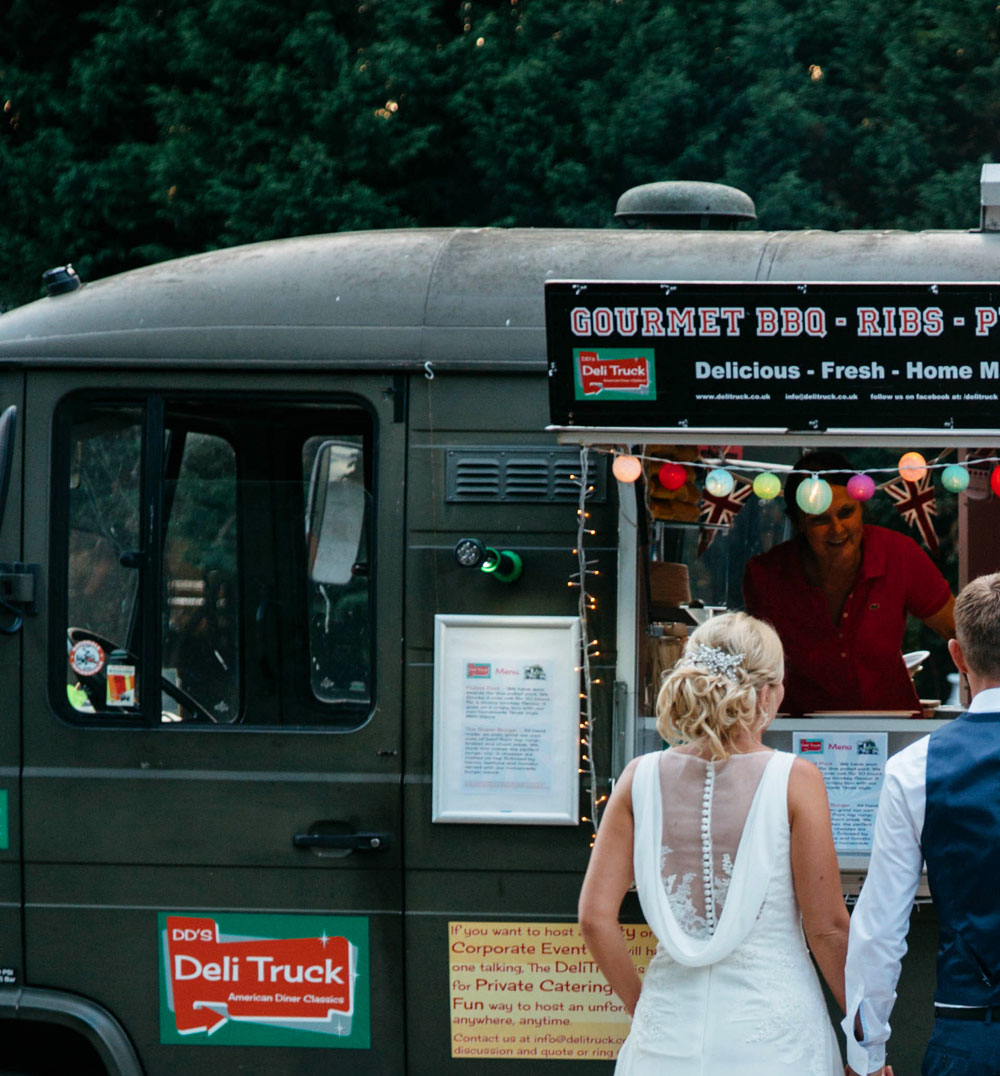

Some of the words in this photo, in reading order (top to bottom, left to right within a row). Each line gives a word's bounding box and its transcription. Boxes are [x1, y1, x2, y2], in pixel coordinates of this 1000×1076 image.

[571, 307, 744, 336] GOURMET
[756, 307, 827, 338] BBQ
[857, 307, 944, 336] RIBS
[582, 365, 607, 376] Deli
[609, 365, 645, 376] Truck
[695, 361, 801, 380] Delicious
[821, 361, 885, 380] Fresh
[906, 361, 973, 380] Home
[828, 743, 852, 751] Menu
[451, 926, 463, 936] If
[464, 927, 488, 939] you
[492, 927, 521, 936] want
[527, 926, 541, 937] to
[545, 925, 573, 937] host
[452, 942, 535, 957] Corporate
[541, 942, 587, 955] Event
[174, 955, 240, 982] Deli
[246, 956, 345, 985] Truck
[452, 964, 475, 973] one
[528, 963, 550, 973] The
[452, 981, 470, 991] for
[476, 979, 534, 992] Private
[540, 979, 613, 996] Catering
[228, 992, 273, 1003] American
[275, 993, 301, 1003] Diner
[303, 994, 345, 1005] Classics
[453, 998, 484, 1010] Fun
[489, 1002, 513, 1013] way
[518, 1000, 531, 1011] to
[535, 1001, 564, 1011] host
[569, 1003, 584, 1011] an
[453, 1015, 515, 1026] anywhere,
[520, 1015, 572, 1027] anytime.
[454, 1034, 499, 1043] Contact
[520, 1035, 530, 1043] at
[454, 1047, 513, 1056] discussion
[517, 1047, 537, 1056] and
[541, 1047, 573, 1058] quote
[593, 1048, 613, 1058] ring
